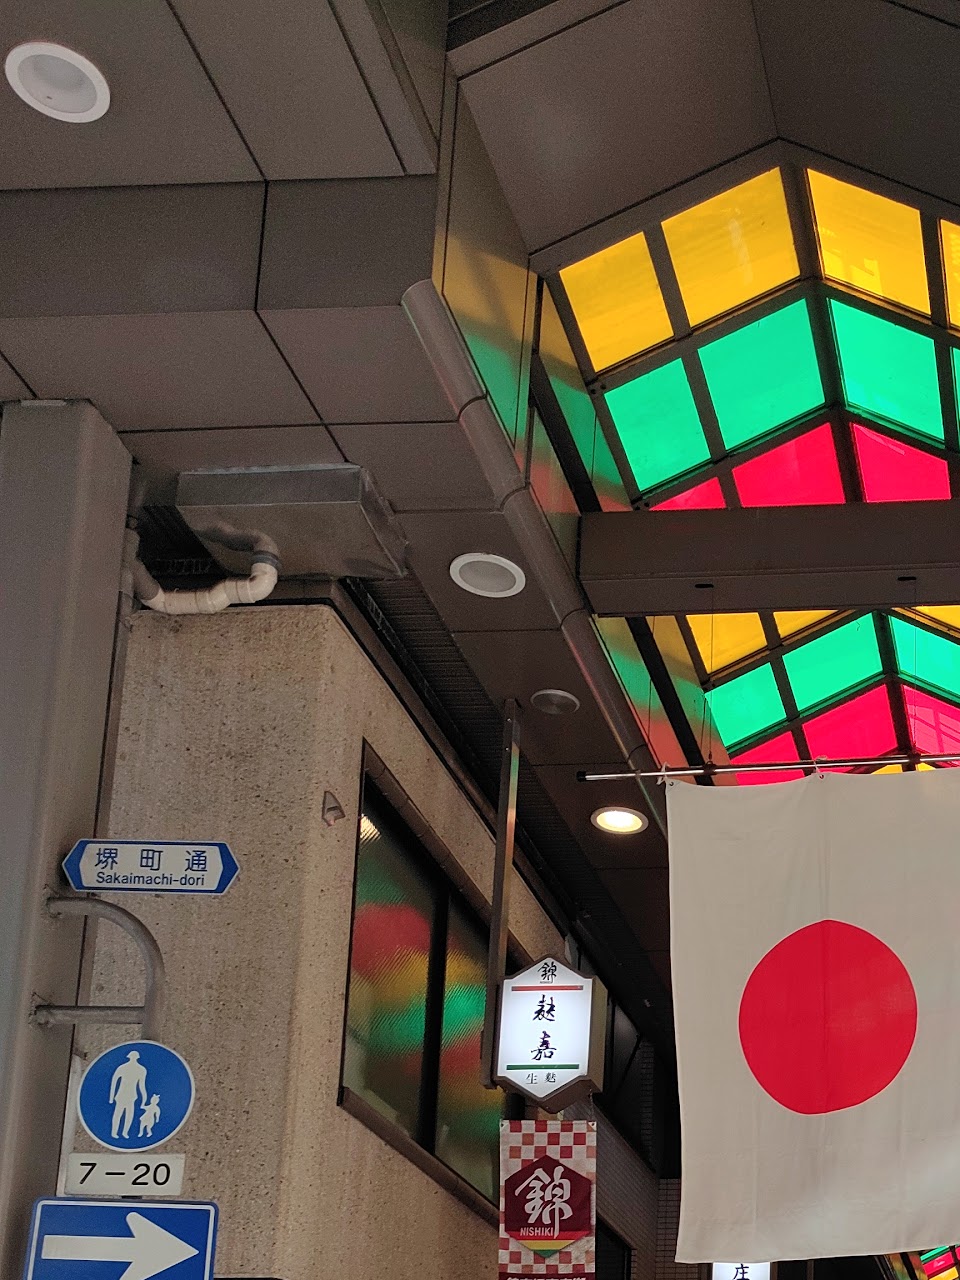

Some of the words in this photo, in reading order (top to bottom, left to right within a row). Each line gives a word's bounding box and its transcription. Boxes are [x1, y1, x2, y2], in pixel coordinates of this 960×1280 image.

[95, 848, 208, 872] 堺町通
[96, 871, 205, 886] Sakaimachi-dori
[515, 1166, 573, 1239] 錦
[520, 1227, 554, 1237] NISHIKI
